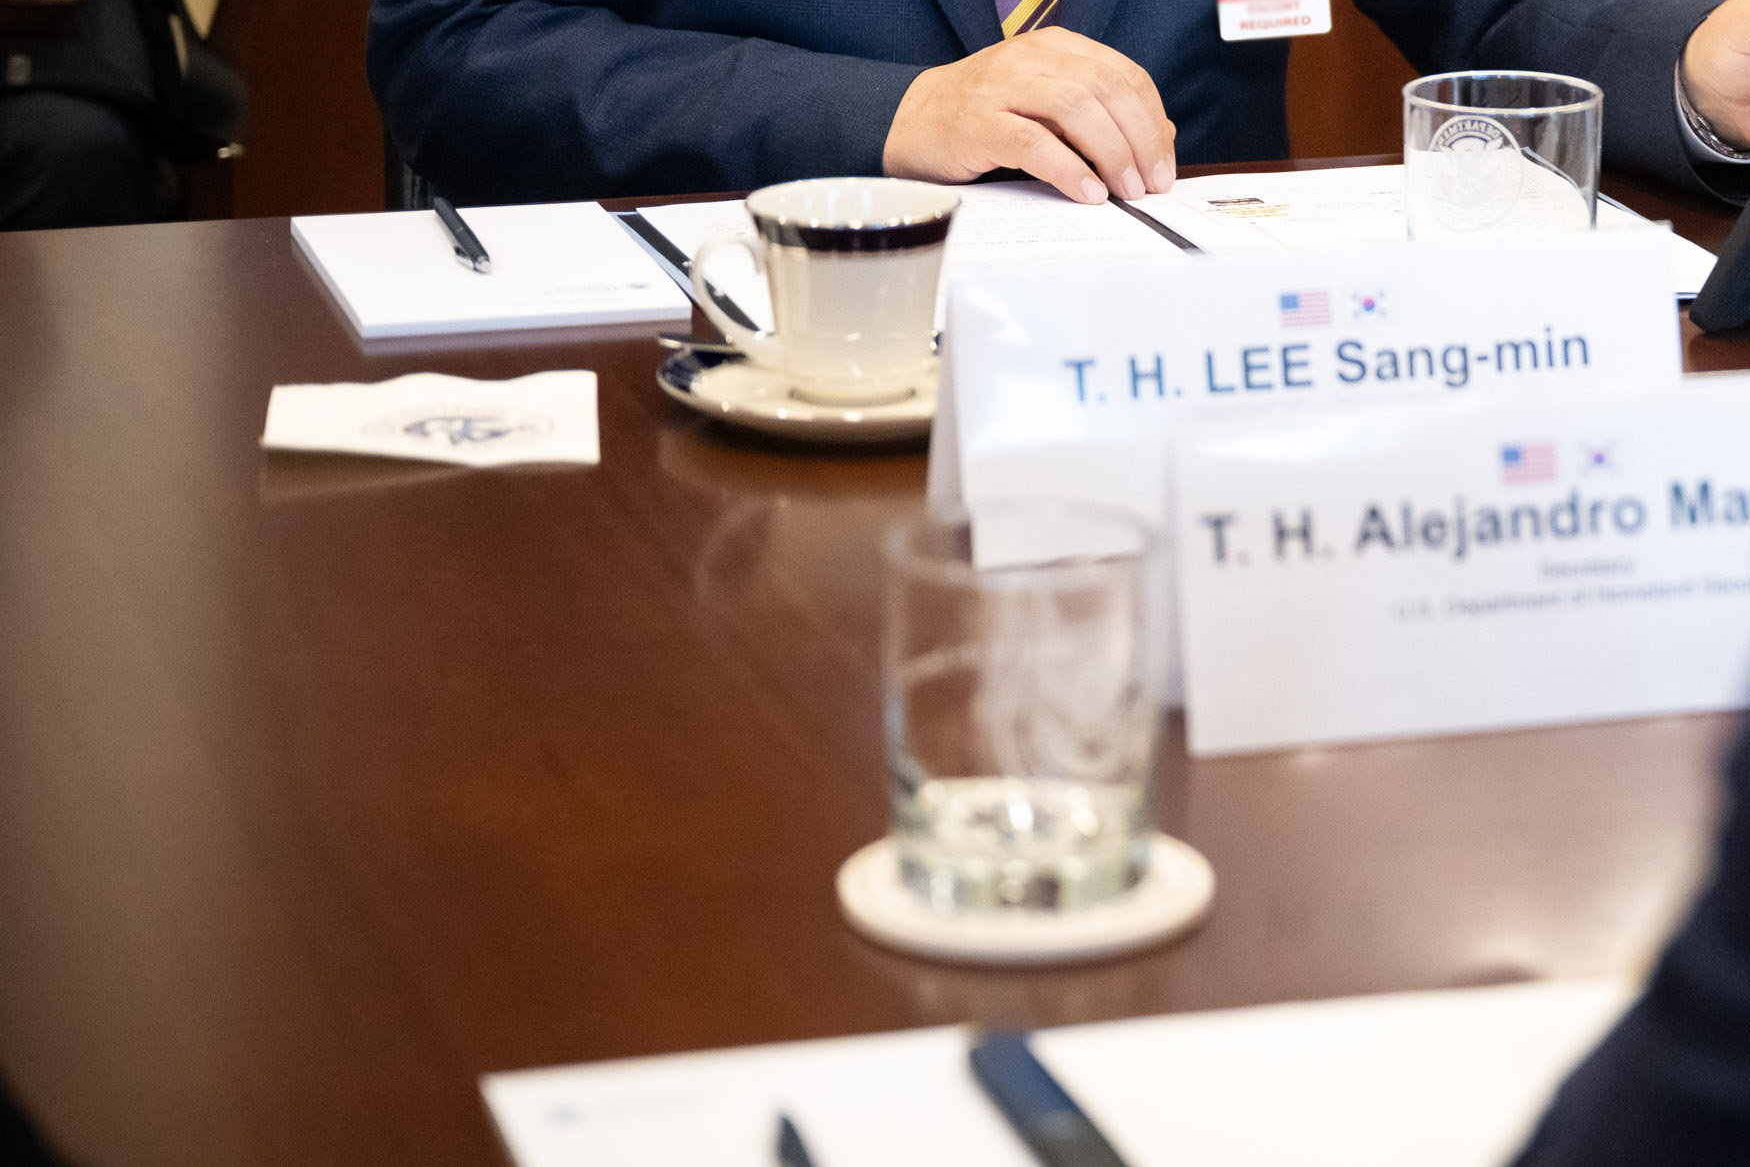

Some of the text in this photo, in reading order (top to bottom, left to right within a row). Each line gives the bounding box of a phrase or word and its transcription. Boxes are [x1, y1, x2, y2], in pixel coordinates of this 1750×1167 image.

[1239, 15, 1312, 31] REQUIRED
[1062, 324, 1591, 403] T. H. LEE Sang-min
[1198, 511, 1250, 568] T.
[1272, 506, 1336, 561] H.
[1354, 490, 1648, 561] Alejandro
